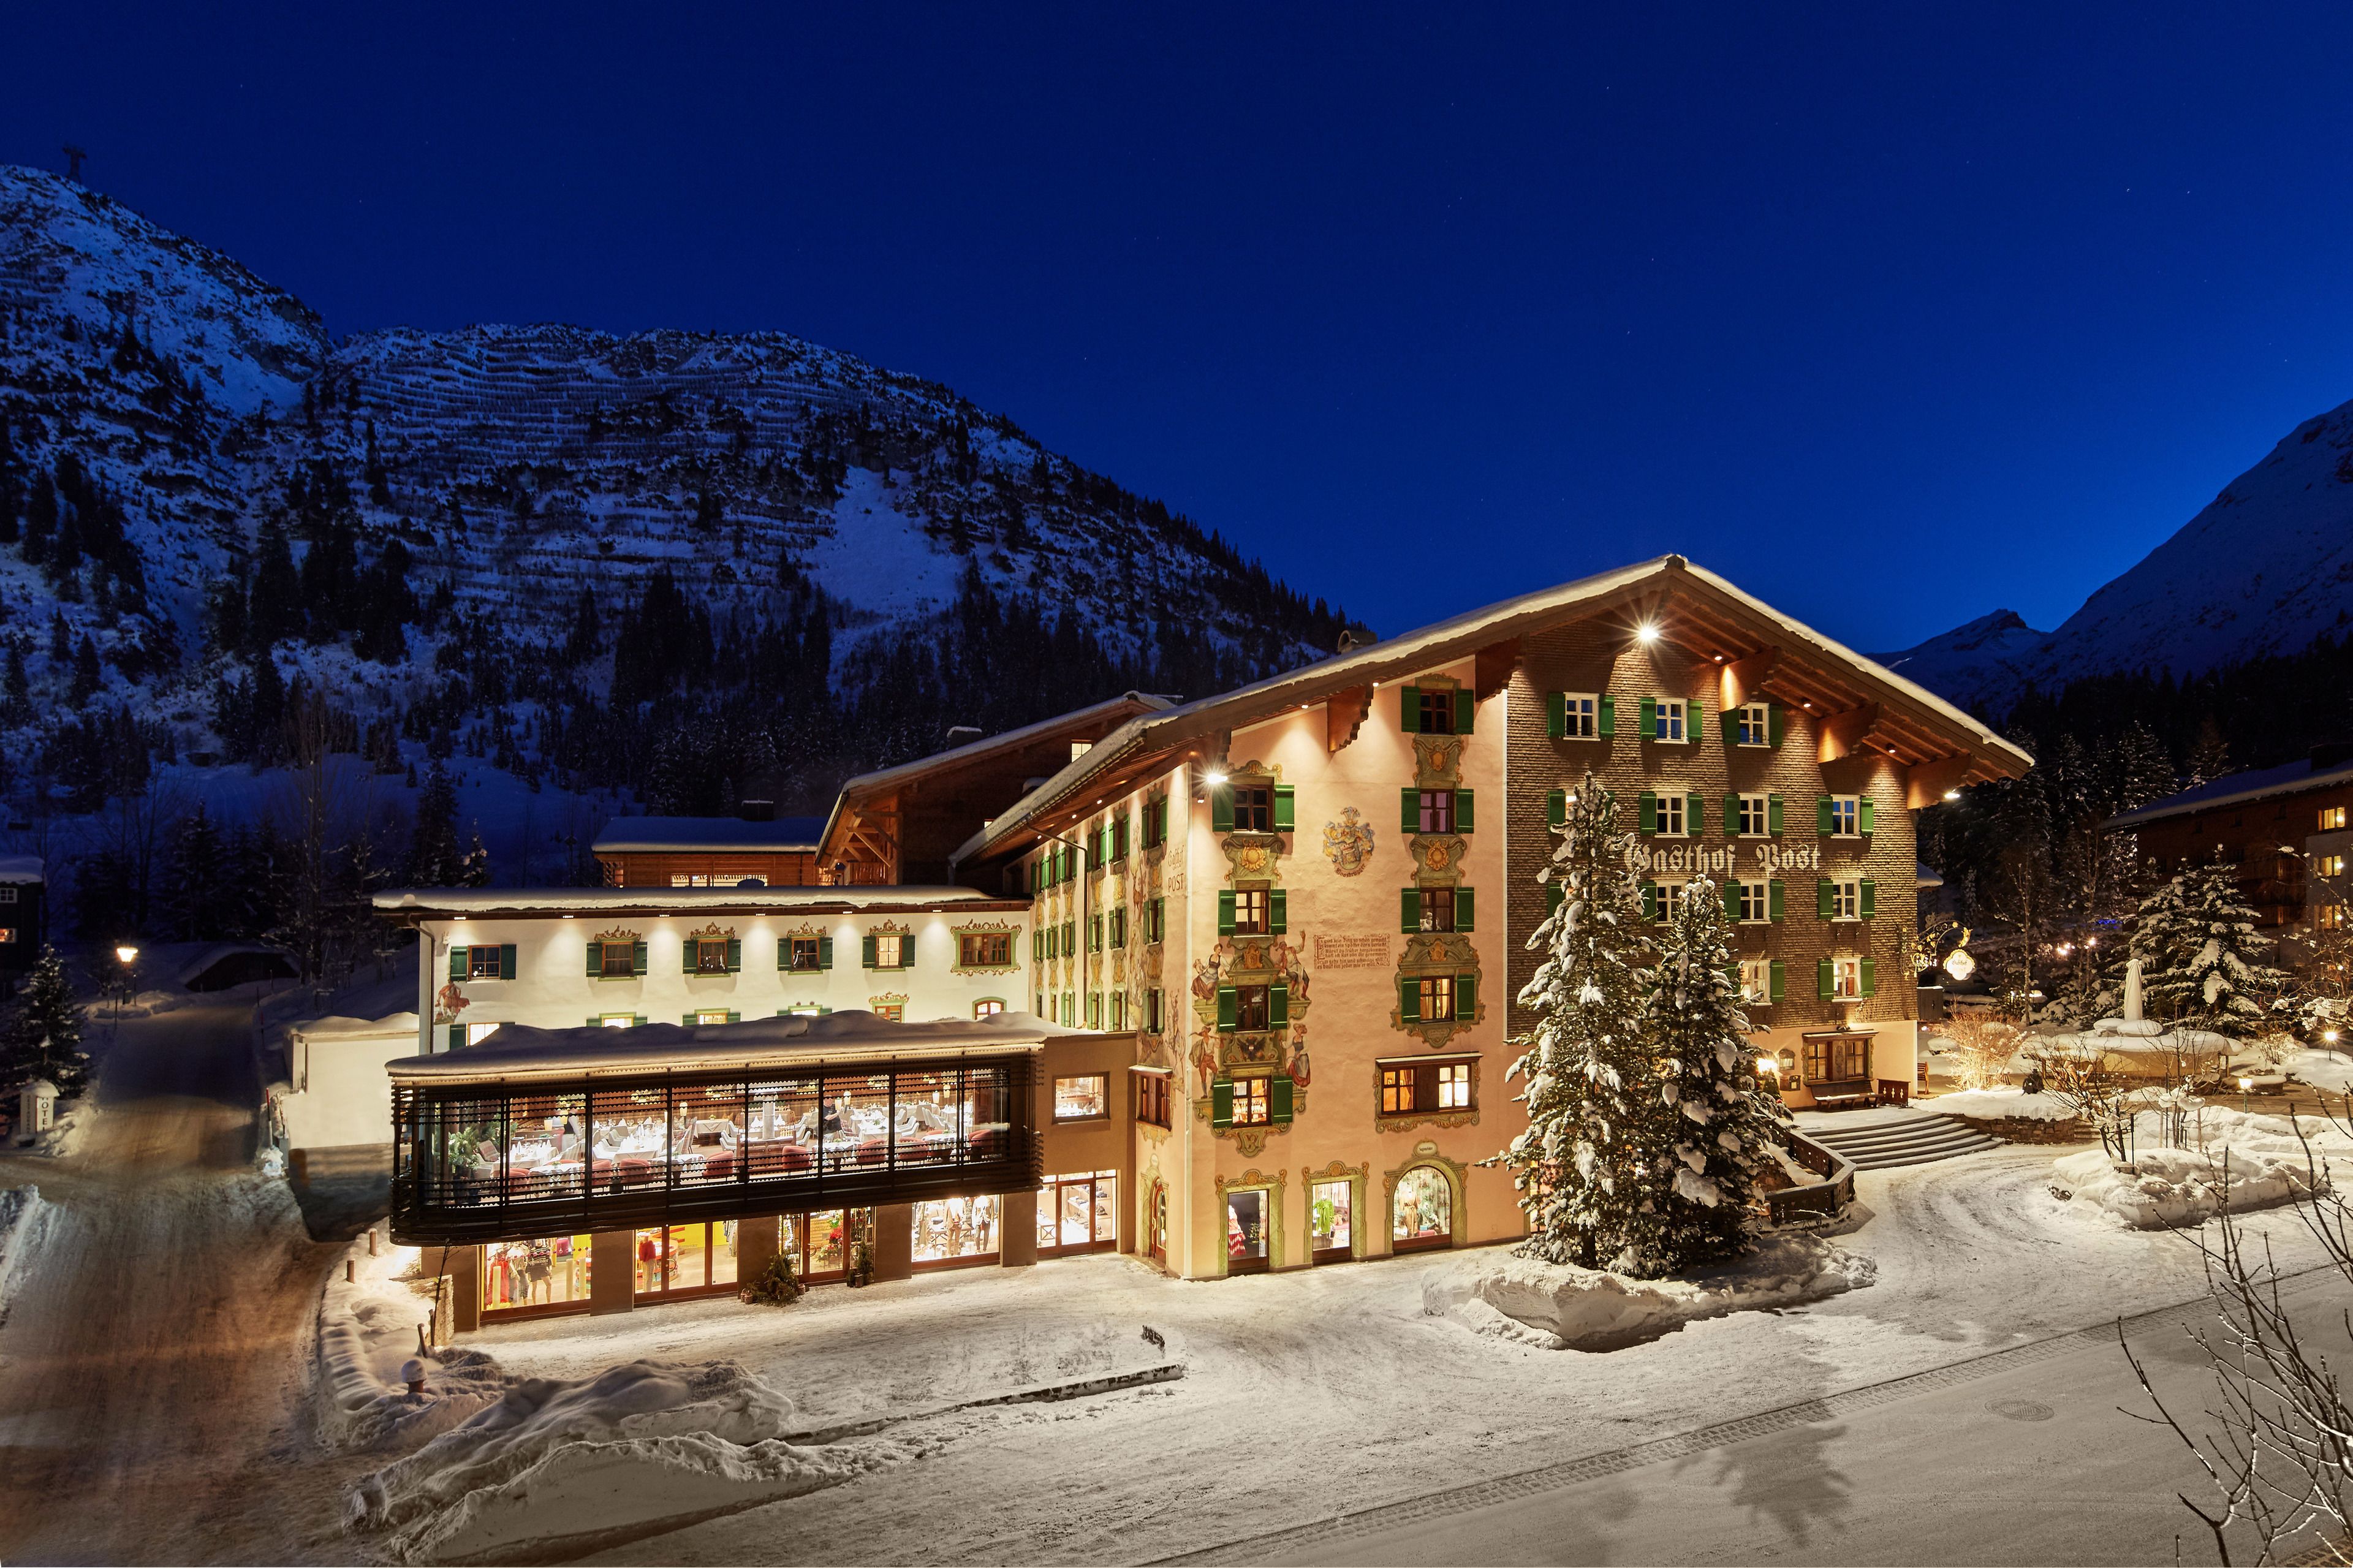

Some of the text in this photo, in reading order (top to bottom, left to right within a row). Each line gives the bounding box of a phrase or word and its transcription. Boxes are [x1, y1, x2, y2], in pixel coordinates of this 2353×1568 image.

[1624, 844, 1821, 879] Gasthof Post
[1168, 873, 1184, 893] POST
